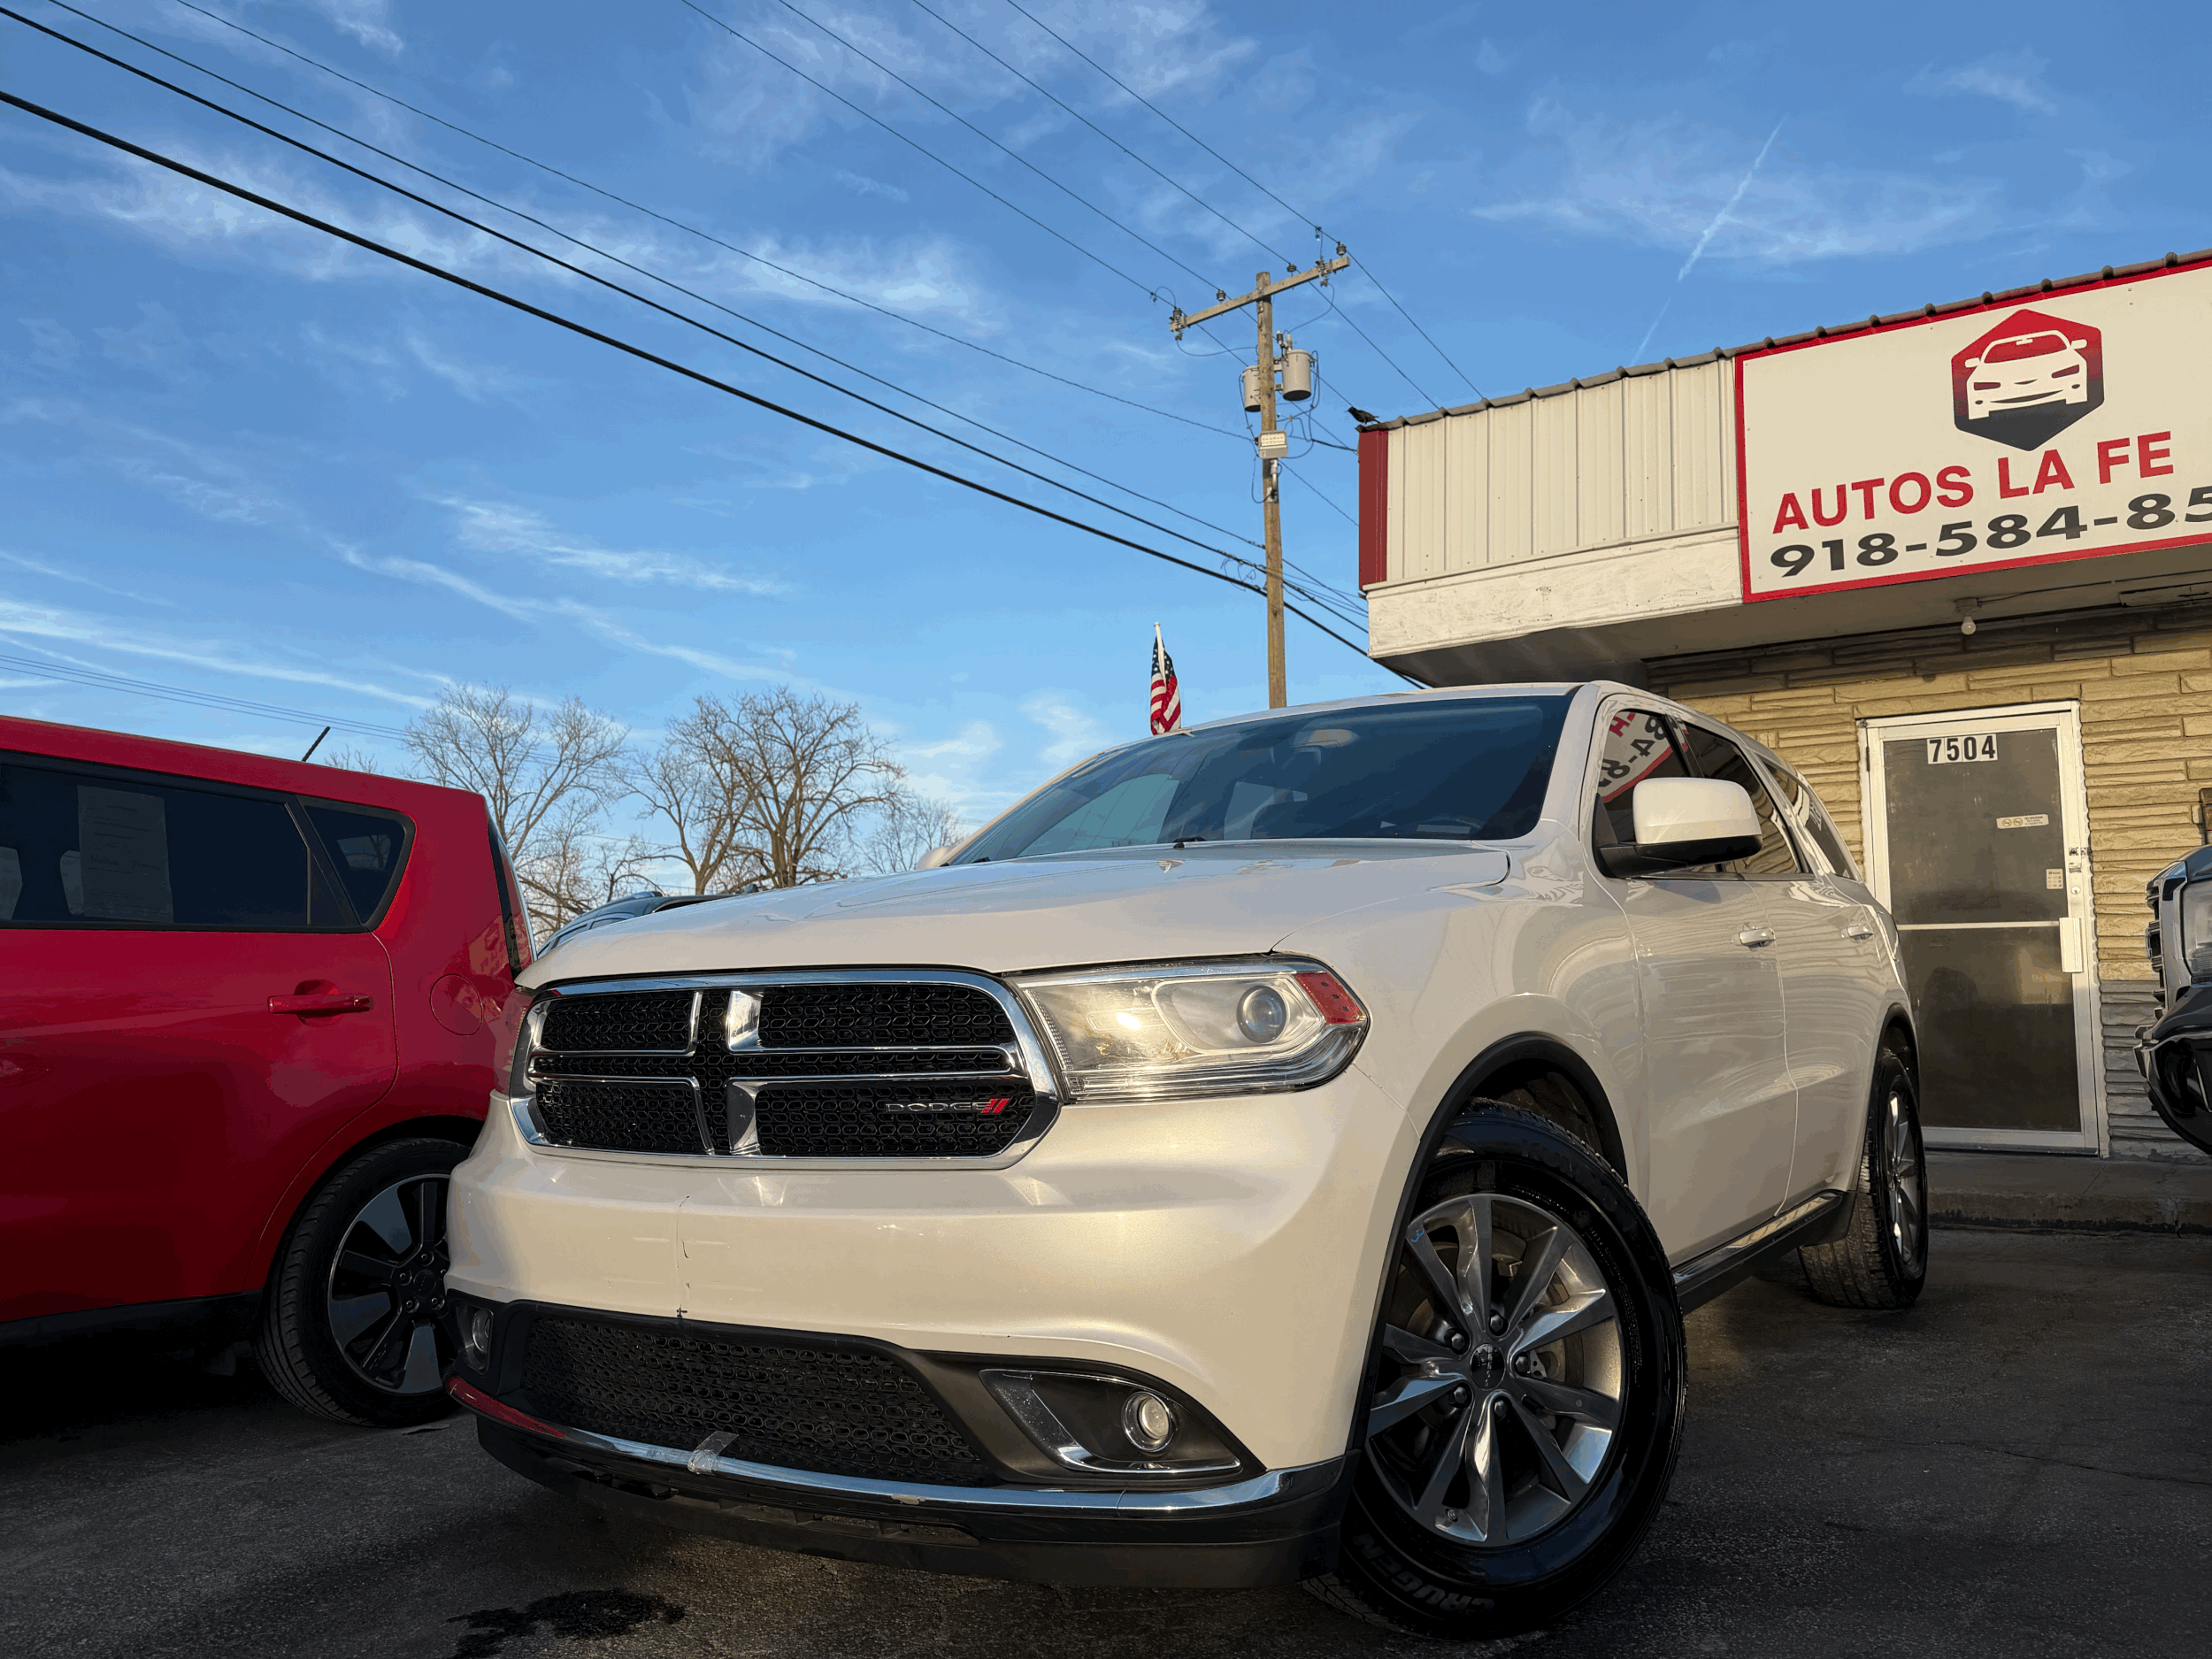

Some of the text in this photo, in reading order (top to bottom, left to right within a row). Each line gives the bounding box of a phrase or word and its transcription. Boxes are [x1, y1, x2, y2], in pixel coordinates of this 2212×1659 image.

[1772, 431, 2174, 534] AUTOS LA FE
[1929, 735, 1996, 763] 7504
[885, 1102, 993, 1112] DODGE
[1350, 1532, 1495, 1616] CRUGEN
